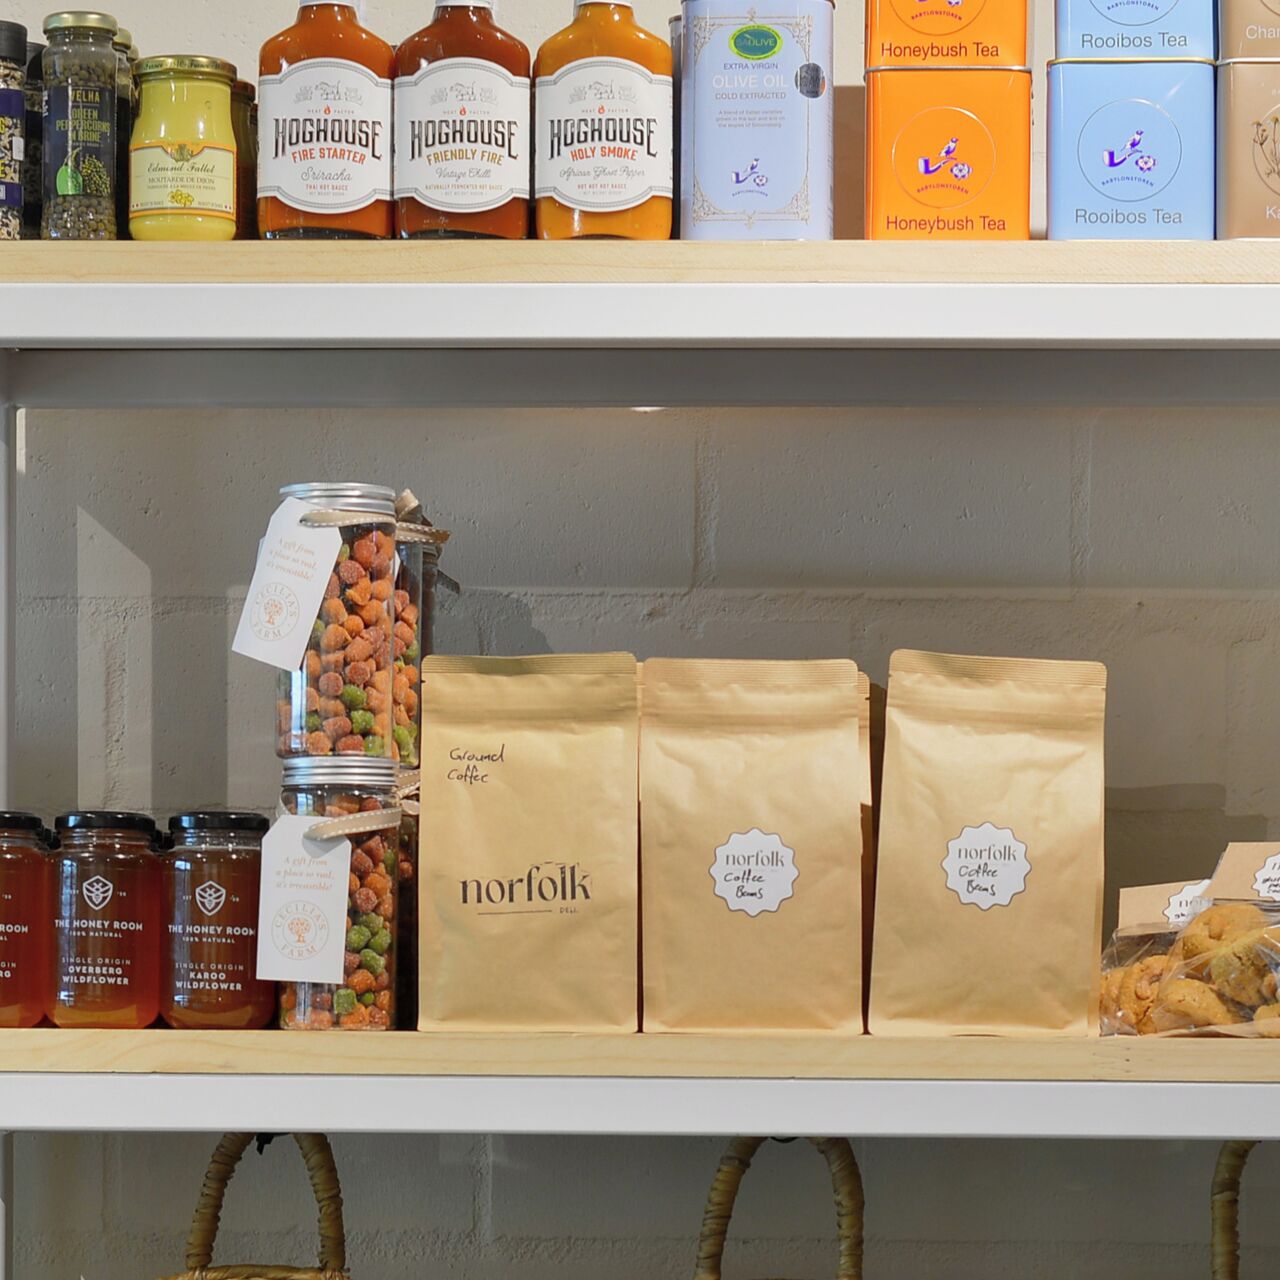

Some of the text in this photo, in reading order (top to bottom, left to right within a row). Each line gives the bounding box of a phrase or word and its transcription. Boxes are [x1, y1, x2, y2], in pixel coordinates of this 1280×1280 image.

[1081, 31, 1188, 49] Rooibos Tea
[881, 42, 1000, 61] Honeybush Tea
[723, 62, 779, 71] EXTRA VIRGIN
[712, 74, 789, 88] OLIVE OIL
[715, 92, 787, 100] COLD EXTRACTED
[273, 118, 383, 161] HOGHOUSE
[409, 119, 519, 162] HOGHOUSE
[548, 118, 658, 161] HOGHOUSE
[291, 147, 366, 165] FIRE STARTER
[426, 148, 505, 166] FRIENDLY FIRE
[570, 145, 638, 162] HOLY SMOKE
[301, 166, 352, 182] Sriracha
[886, 215, 1007, 234] Honeybush Tea
[1075, 208, 1183, 225] Rooibos Tea
[449, 743, 506, 763] Ground
[448, 764, 489, 786] Coffee
[725, 850, 785, 867] norfolk
[958, 844, 1017, 862] norfolk
[460, 862, 591, 905] norfolk
[55, 919, 143, 931] THE HONEY ROOM
[168, 924, 224, 935] THE HONEY
[68, 966, 123, 976] OVERBERG
[189, 971, 226, 981] KAROO
[62, 975, 129, 986] WILDFLOWER
[176, 980, 242, 991] WILDFLOWER
